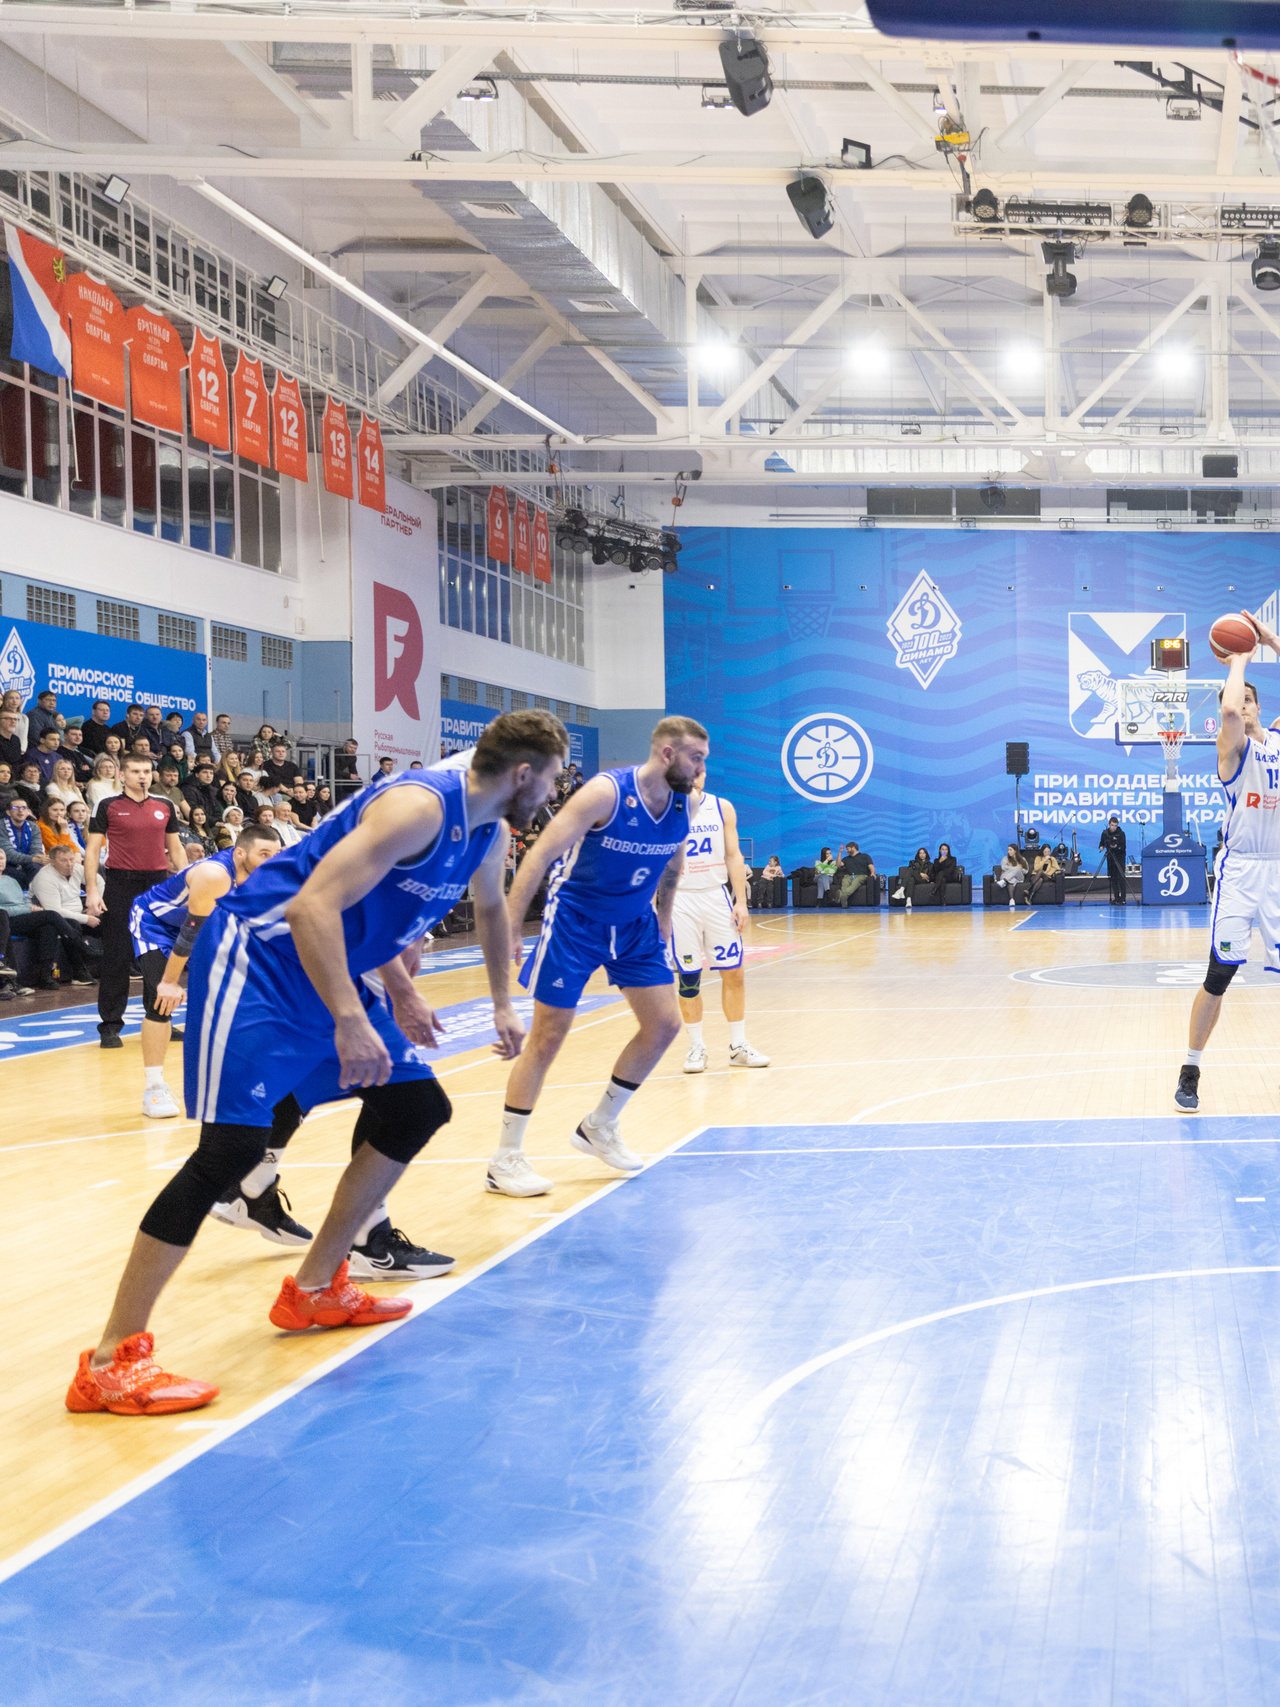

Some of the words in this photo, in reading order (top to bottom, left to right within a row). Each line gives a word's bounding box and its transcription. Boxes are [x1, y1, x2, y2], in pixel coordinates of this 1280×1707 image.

[86, 322, 111, 344] СПАРТАК
[143, 353, 168, 371] СПАРТАК
[198, 367, 219, 403] 12
[245, 389, 257, 418] 7
[280, 407, 298, 439] 12
[330, 430, 346, 458] 13
[364, 446, 379, 474] 14
[381, 515, 413, 536] ПАРТНЕР
[385, 505, 421, 529] ЕРАЛЬНЫЙ
[901, 645, 952, 662] ДИНАМО
[48, 663, 135, 688] ПРИМОРСКОЕ
[49, 679, 133, 703] СПОРТИВНОЕ
[135, 691, 196, 711] ОБЩЕСТВО
[1152, 692, 1189, 702] PARI
[374, 729, 394, 741] Русская
[1035, 774, 1078, 788] ПРИ
[1084, 774, 1224, 789] ПОДДЕЖКЕ
[1034, 792, 1224, 806] ПРАВИТЕЛЬТВА
[1014, 809, 1163, 824] ПРИМОРСКОГ
[1186, 809, 1225, 824] КРА
[689, 824, 719, 834] НАМО
[686, 837, 712, 857] 24
[631, 867, 651, 887] 6
[713, 942, 740, 961] 24
